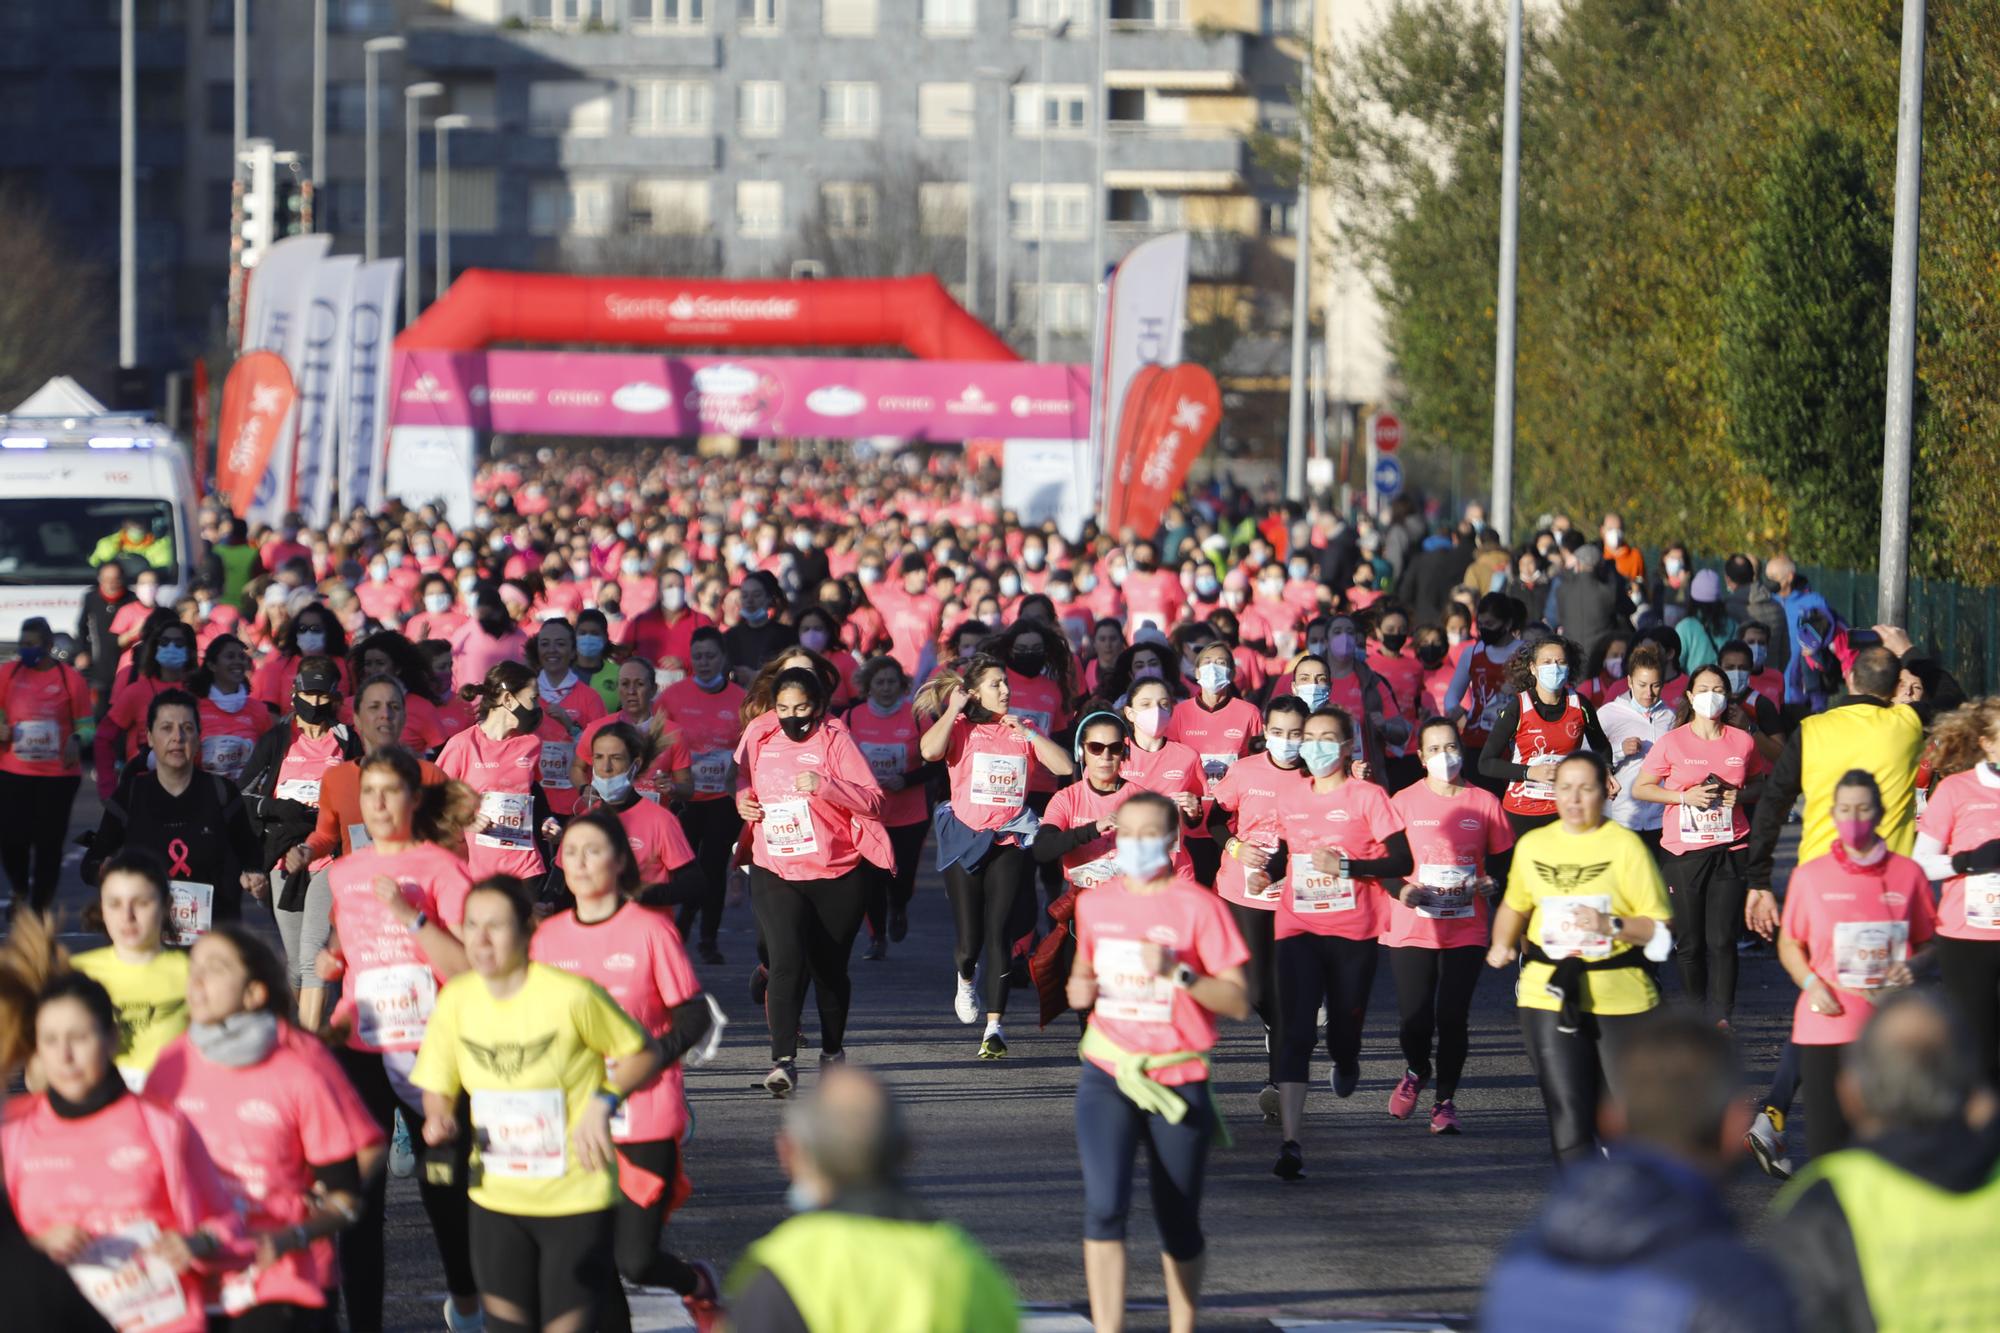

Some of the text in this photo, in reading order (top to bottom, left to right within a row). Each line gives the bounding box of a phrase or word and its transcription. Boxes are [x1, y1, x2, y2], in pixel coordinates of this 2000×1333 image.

[1186, 729, 1208, 737] OYSHO
[1683, 758, 1709, 766] OYSHO
[989, 774, 1011, 785] 016
[1248, 788, 1276, 797] OYSHO
[498, 815, 520, 828] 016
[1696, 812, 1718, 822] 016
[1413, 819, 1440, 827] OYSHO
[772, 823, 795, 835] 016
[1306, 876, 1332, 889] 016
[1437, 886, 1461, 896] 016
